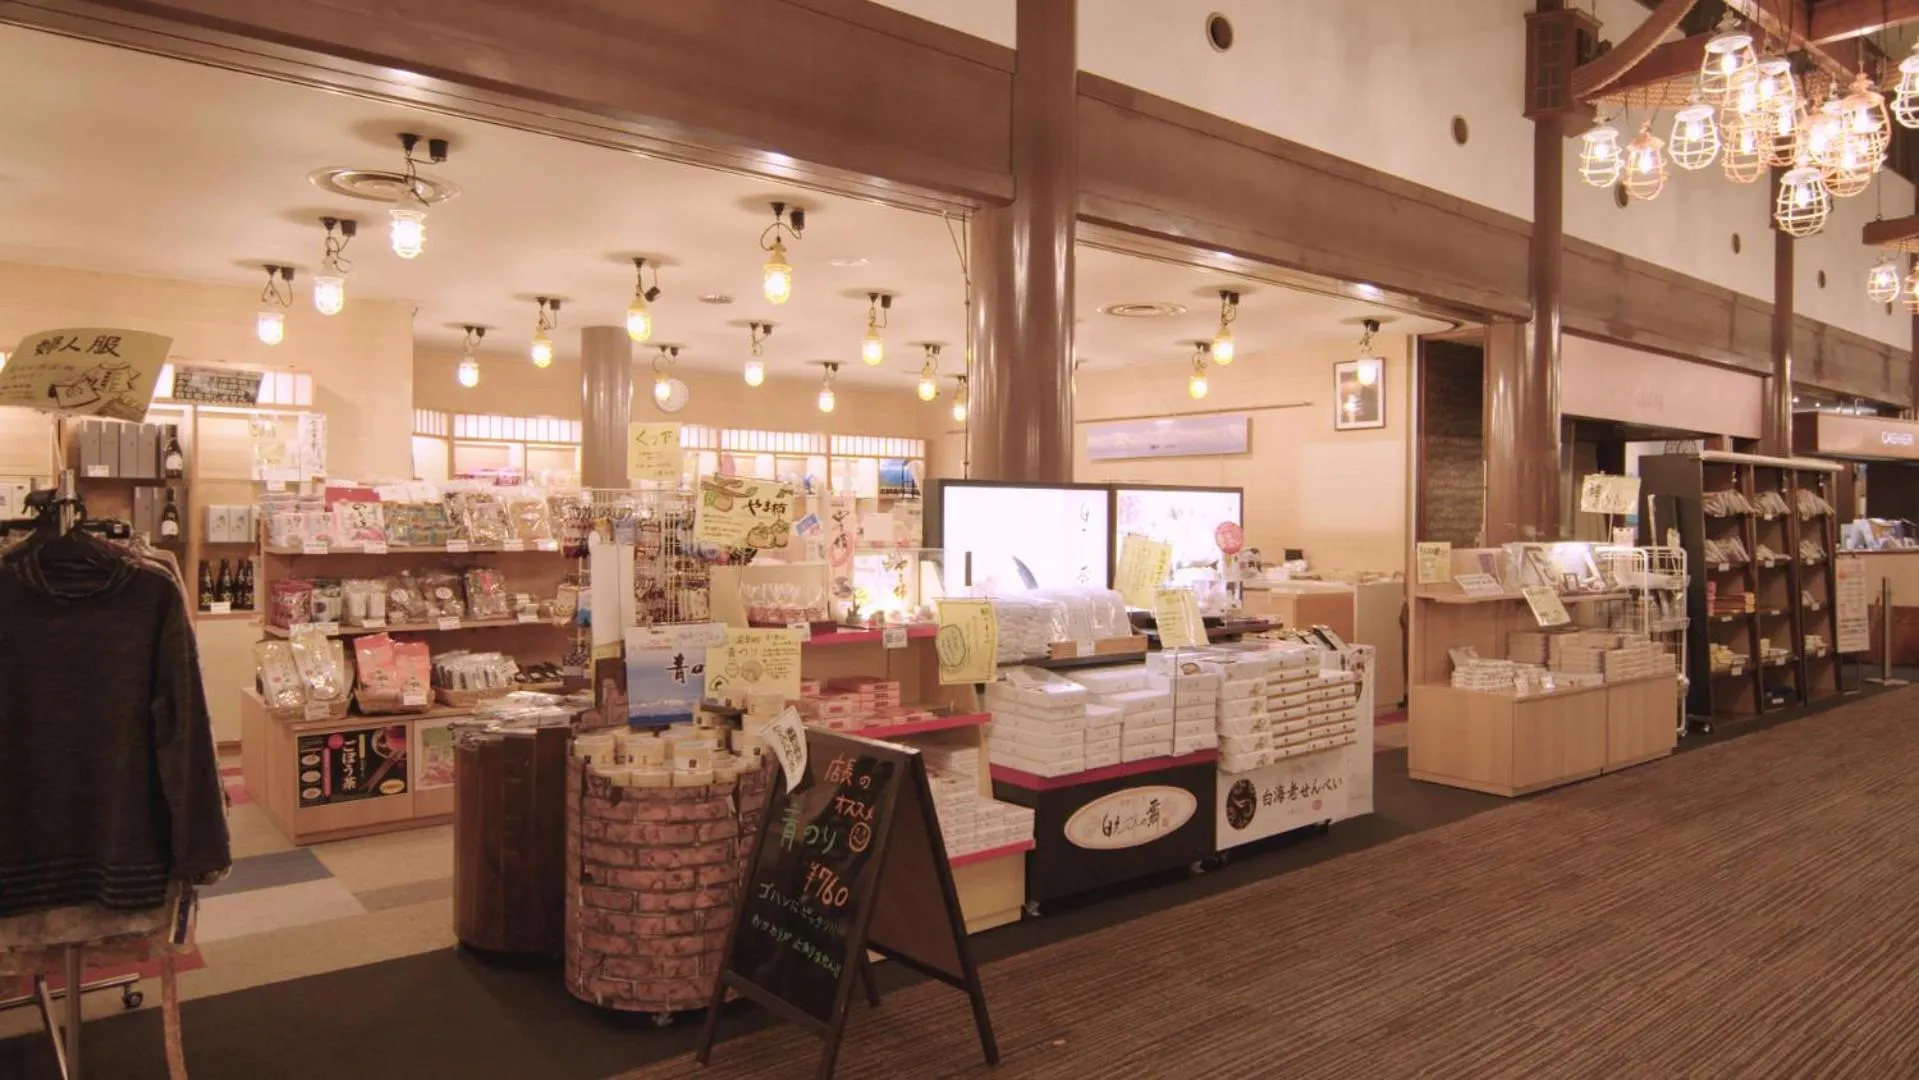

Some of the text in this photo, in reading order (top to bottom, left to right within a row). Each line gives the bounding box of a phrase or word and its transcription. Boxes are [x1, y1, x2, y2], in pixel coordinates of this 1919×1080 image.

[34, 335, 122, 357] 婦人服
[1262, 777, 1343, 807] 白海老せんべい
[834, 796, 875, 821] オススメ
[780, 803, 838, 854] 青のり
[804, 861, 849, 907] ¥760
